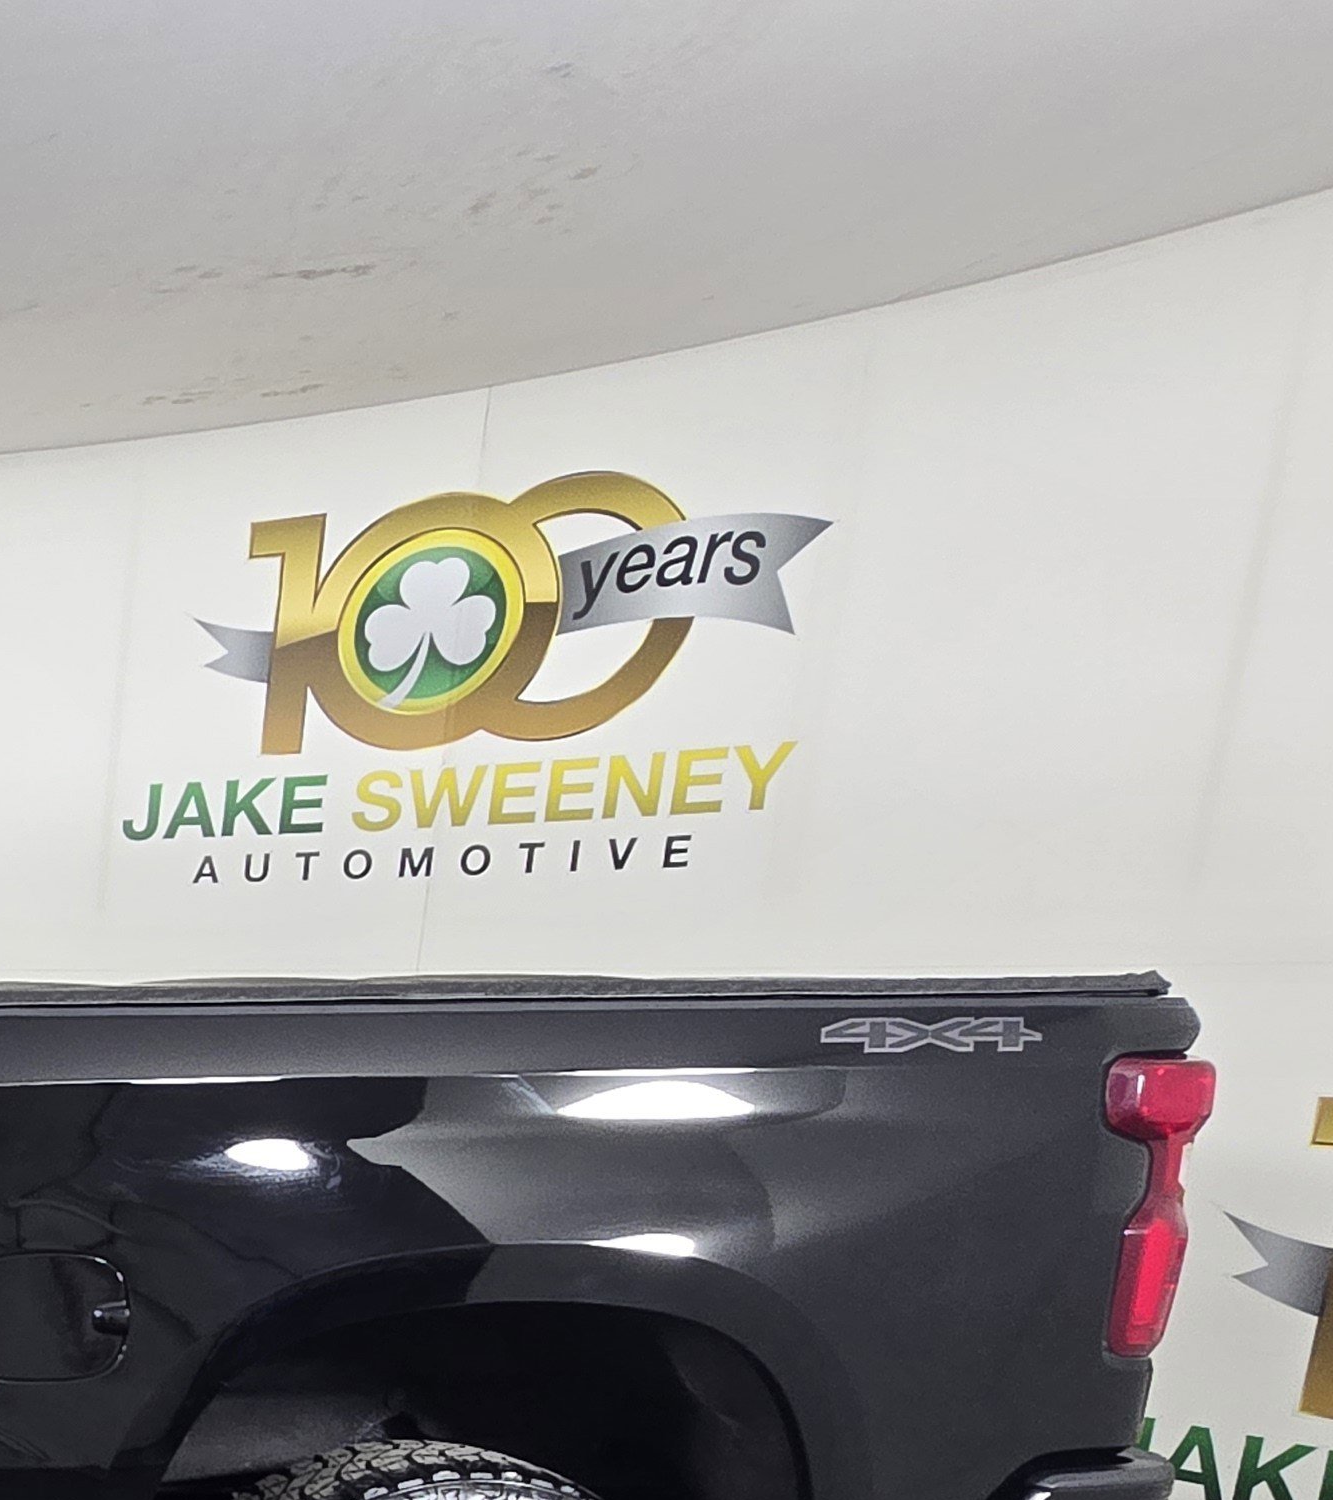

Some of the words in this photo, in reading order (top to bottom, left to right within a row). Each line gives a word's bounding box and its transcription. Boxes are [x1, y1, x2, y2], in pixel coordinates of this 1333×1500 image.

[249, 470, 698, 755] 100
[573, 530, 767, 621] years
[122, 774, 328, 841] JAKE
[351, 740, 798, 832] SWEENEY
[193, 834, 693, 884] AUTOMOTIVE
